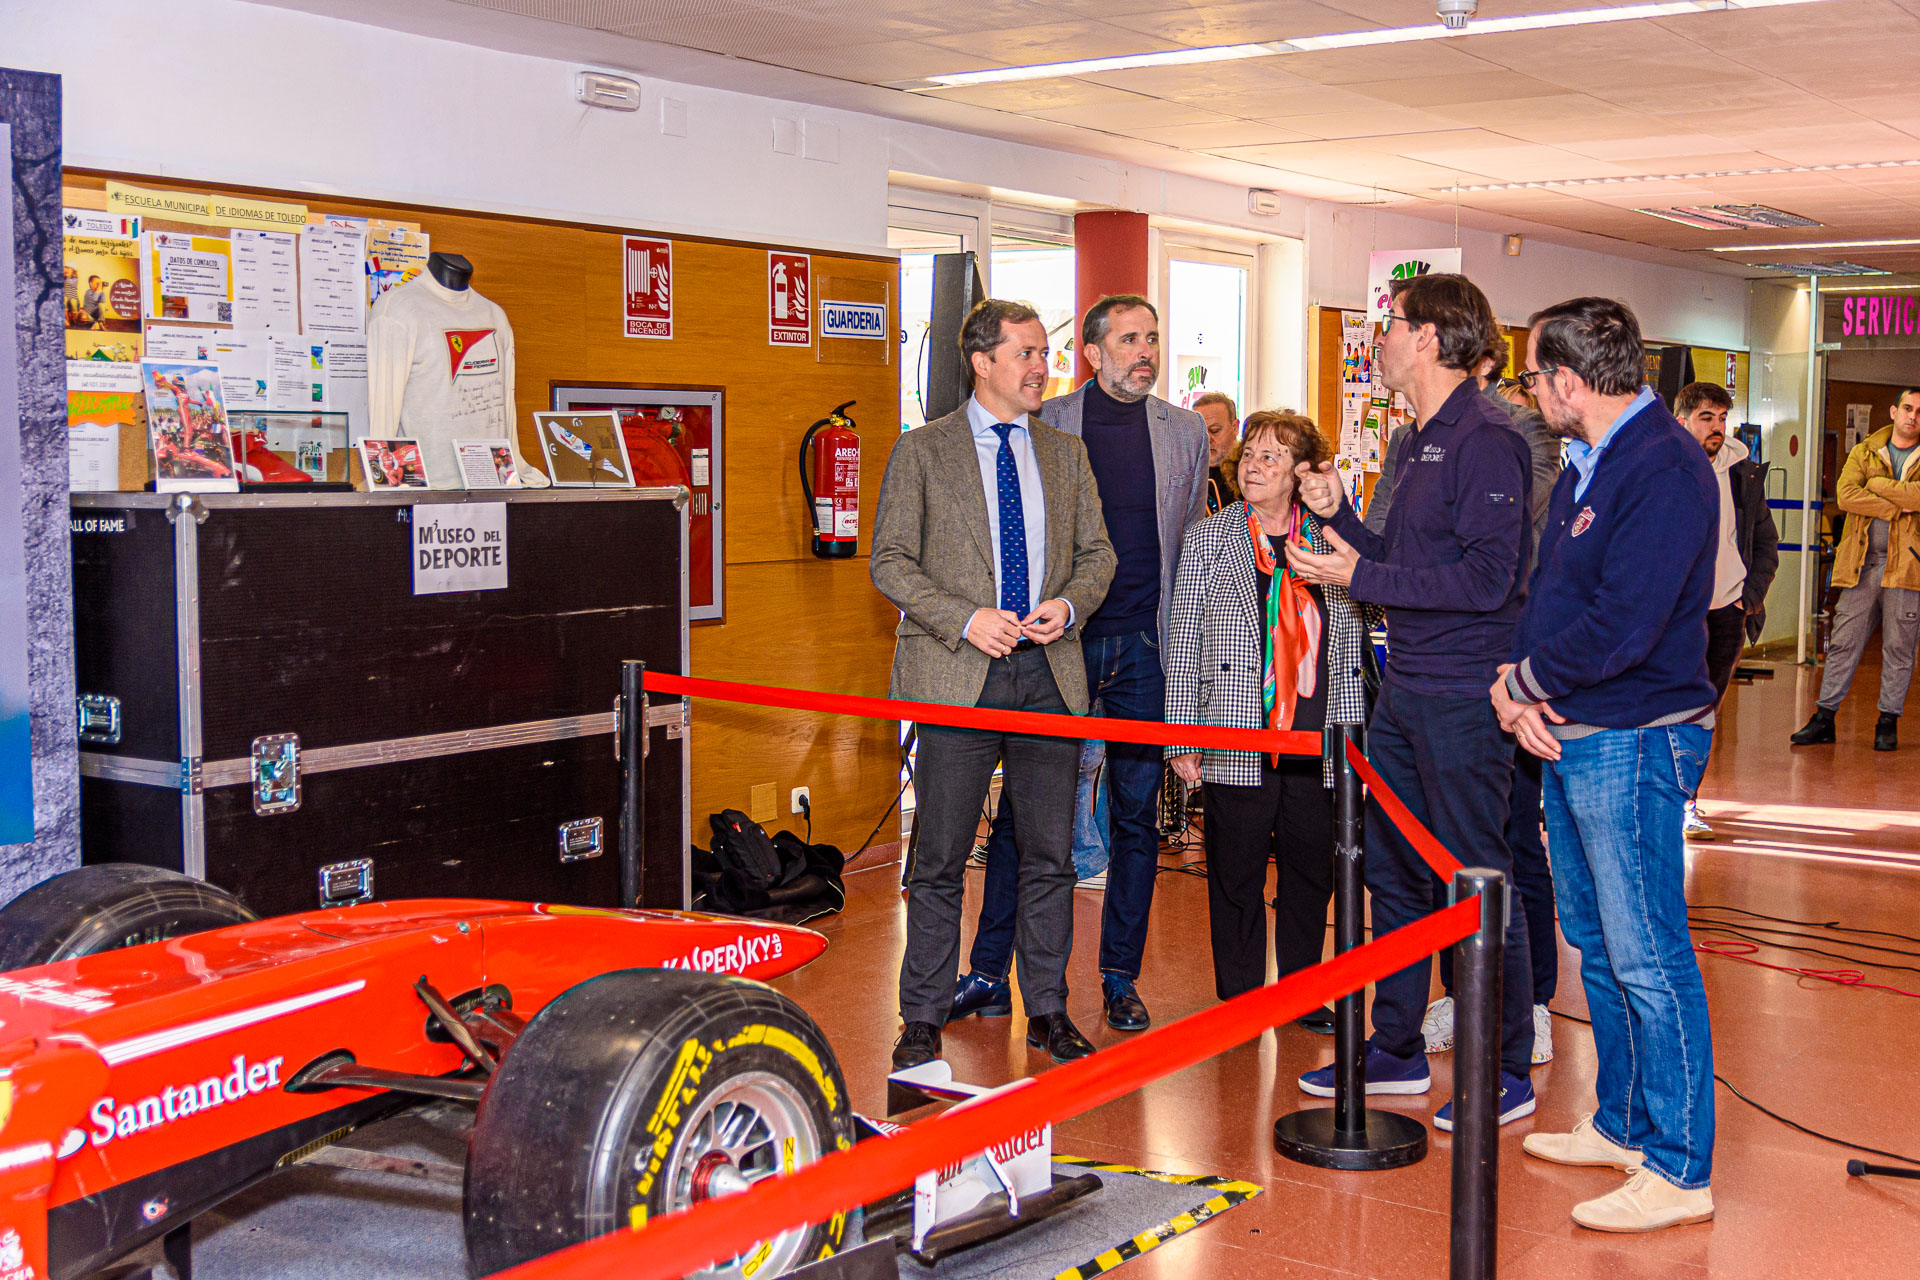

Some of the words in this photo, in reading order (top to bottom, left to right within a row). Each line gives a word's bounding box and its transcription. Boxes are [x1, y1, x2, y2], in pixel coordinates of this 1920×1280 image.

[125, 194, 161, 207] ESCUELA
[165, 200, 209, 214] MUNICIPAL
[215, 205, 227, 215] DE
[229, 207, 264, 219] IDIOMAS
[265, 211, 275, 221] DE
[276, 212, 306, 223] TOLEDO
[87, 222, 113, 230] TOLEDO
[170, 256, 186, 264] DATOS
[187, 257, 193, 265] DE
[194, 258, 218, 267] CONTACTO
[827, 309, 881, 331] GUARDERIA
[1842, 295, 1920, 336] SERVIC
[630, 320, 653, 328] BOCA
[630, 327, 668, 335] INCENDIO
[773, 331, 807, 342] EXTINTOR
[70, 519, 84, 532] ALL
[84, 519, 98, 532] OF
[99, 519, 125, 532] FAME
[483, 531, 502, 542] DEL
[419, 546, 502, 570] DEPORTE
[90, 1054, 284, 1146] Santander
